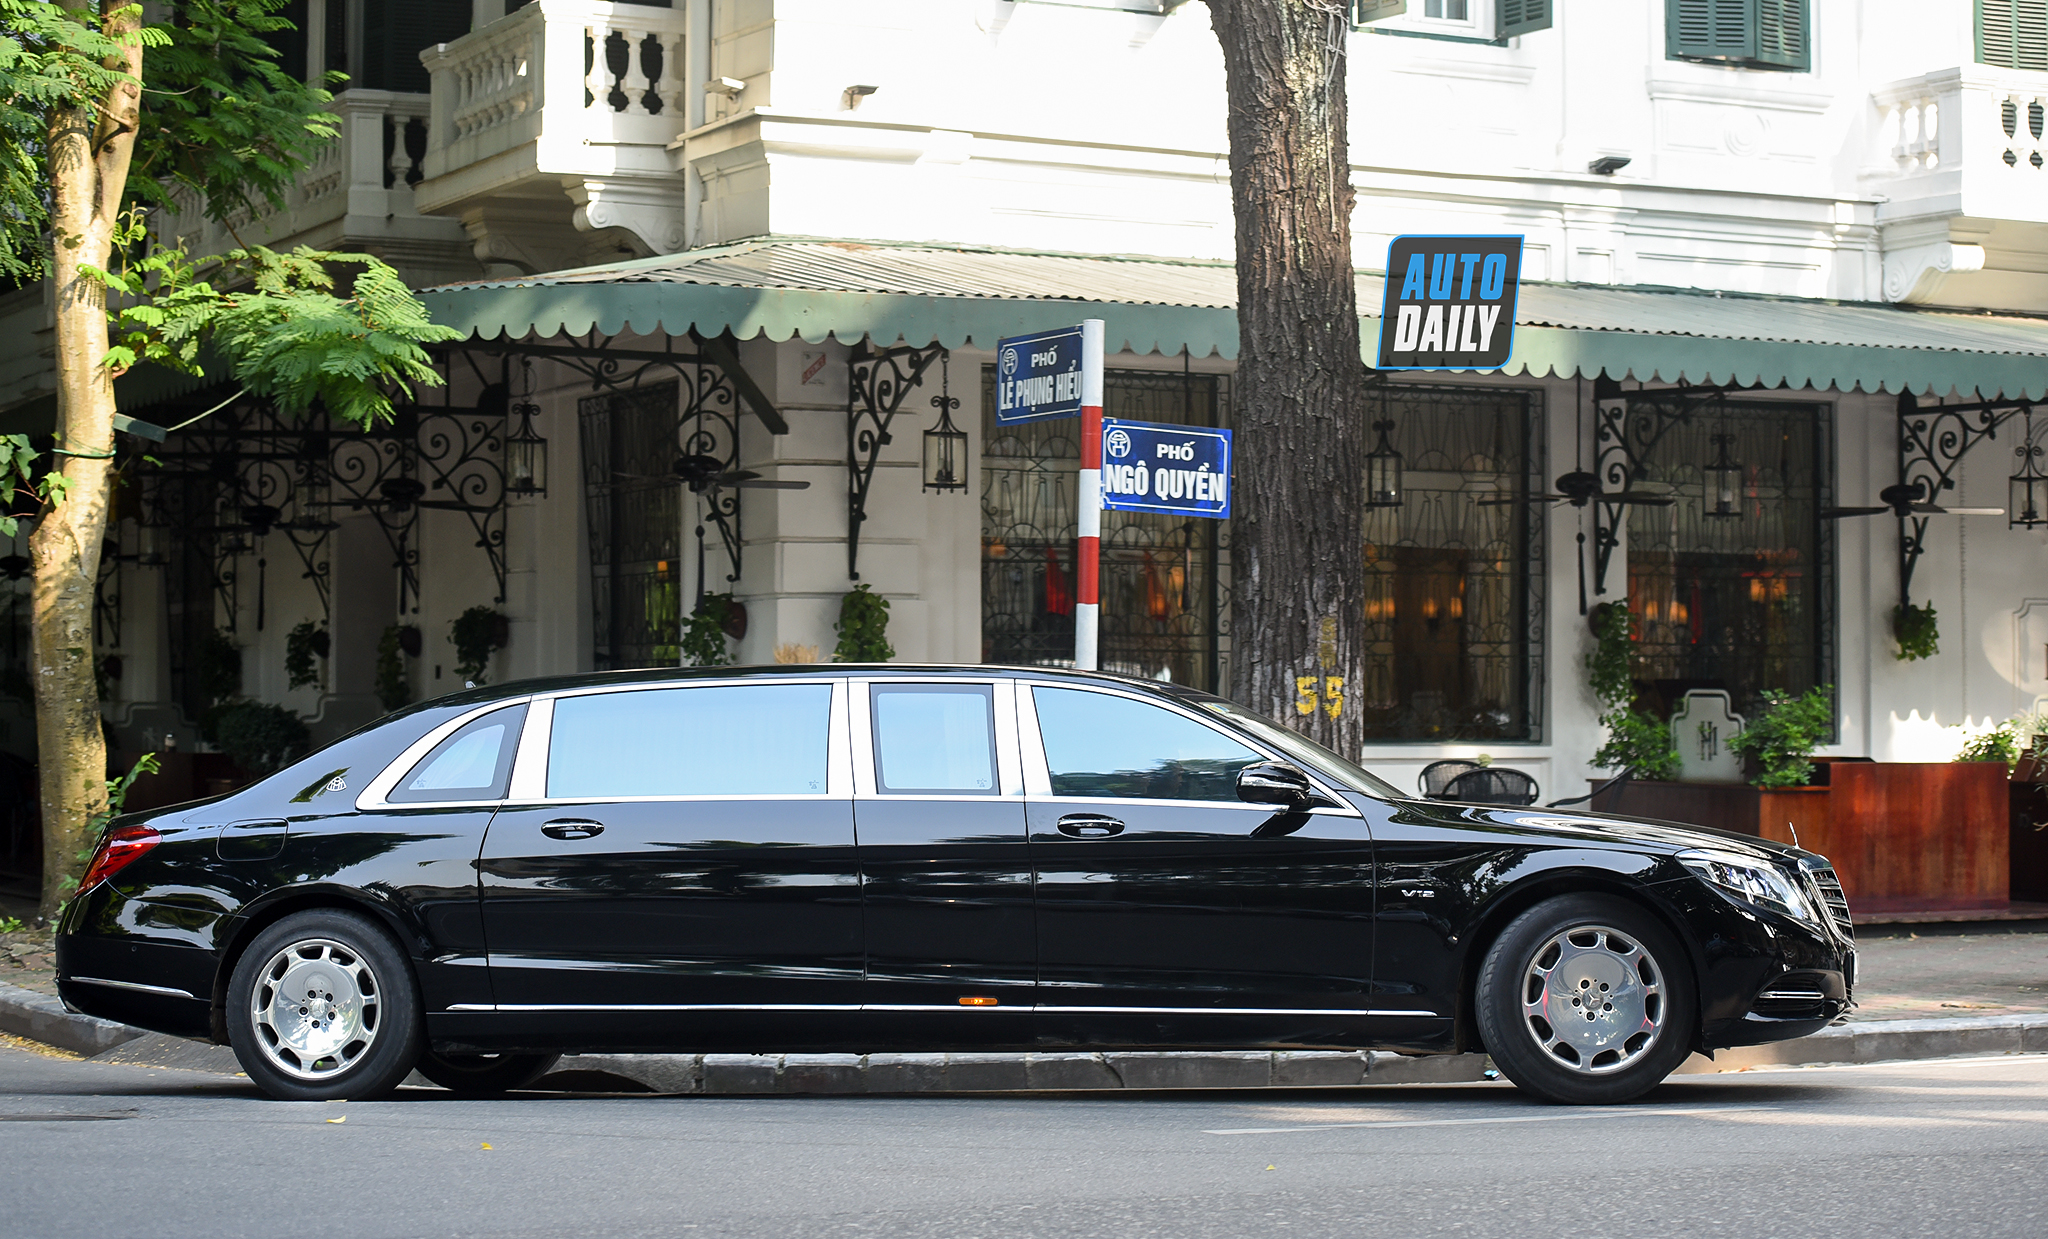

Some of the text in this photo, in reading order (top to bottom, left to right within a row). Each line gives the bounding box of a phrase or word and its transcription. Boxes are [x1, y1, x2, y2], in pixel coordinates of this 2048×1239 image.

[1031, 345, 1058, 368] PHỐ
[1000, 360, 1082, 411] LÊ PHỤNG HIỂU
[1156, 441, 1196, 462] PHỐ
[1105, 460, 1224, 502] NGÔ QUYỀN
[1295, 676, 1344, 722] 55
[1401, 889, 1435, 898] V12
